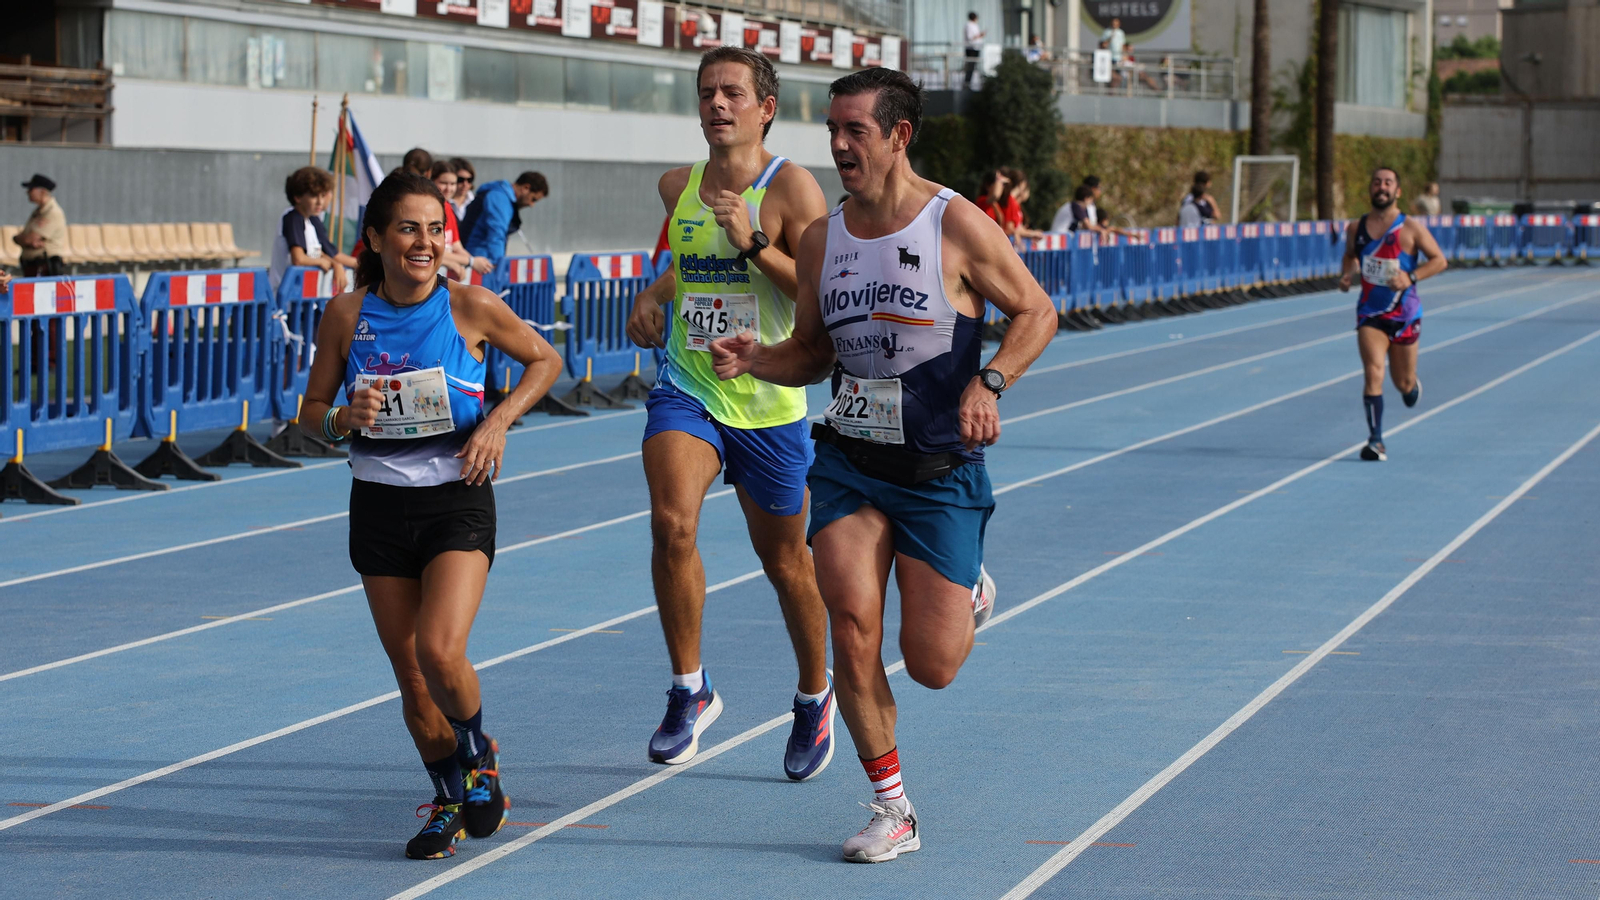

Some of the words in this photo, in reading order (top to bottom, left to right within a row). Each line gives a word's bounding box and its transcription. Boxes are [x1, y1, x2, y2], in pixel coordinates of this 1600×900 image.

[1098, 1, 1159, 17] HOTELS
[682, 270, 713, 283] Ciudad
[713, 271, 726, 283] de
[823, 281, 929, 319] Movijerez
[683, 310, 728, 334] 1015
[407, 359, 423, 367] CLUB
[830, 392, 868, 418] 1022
